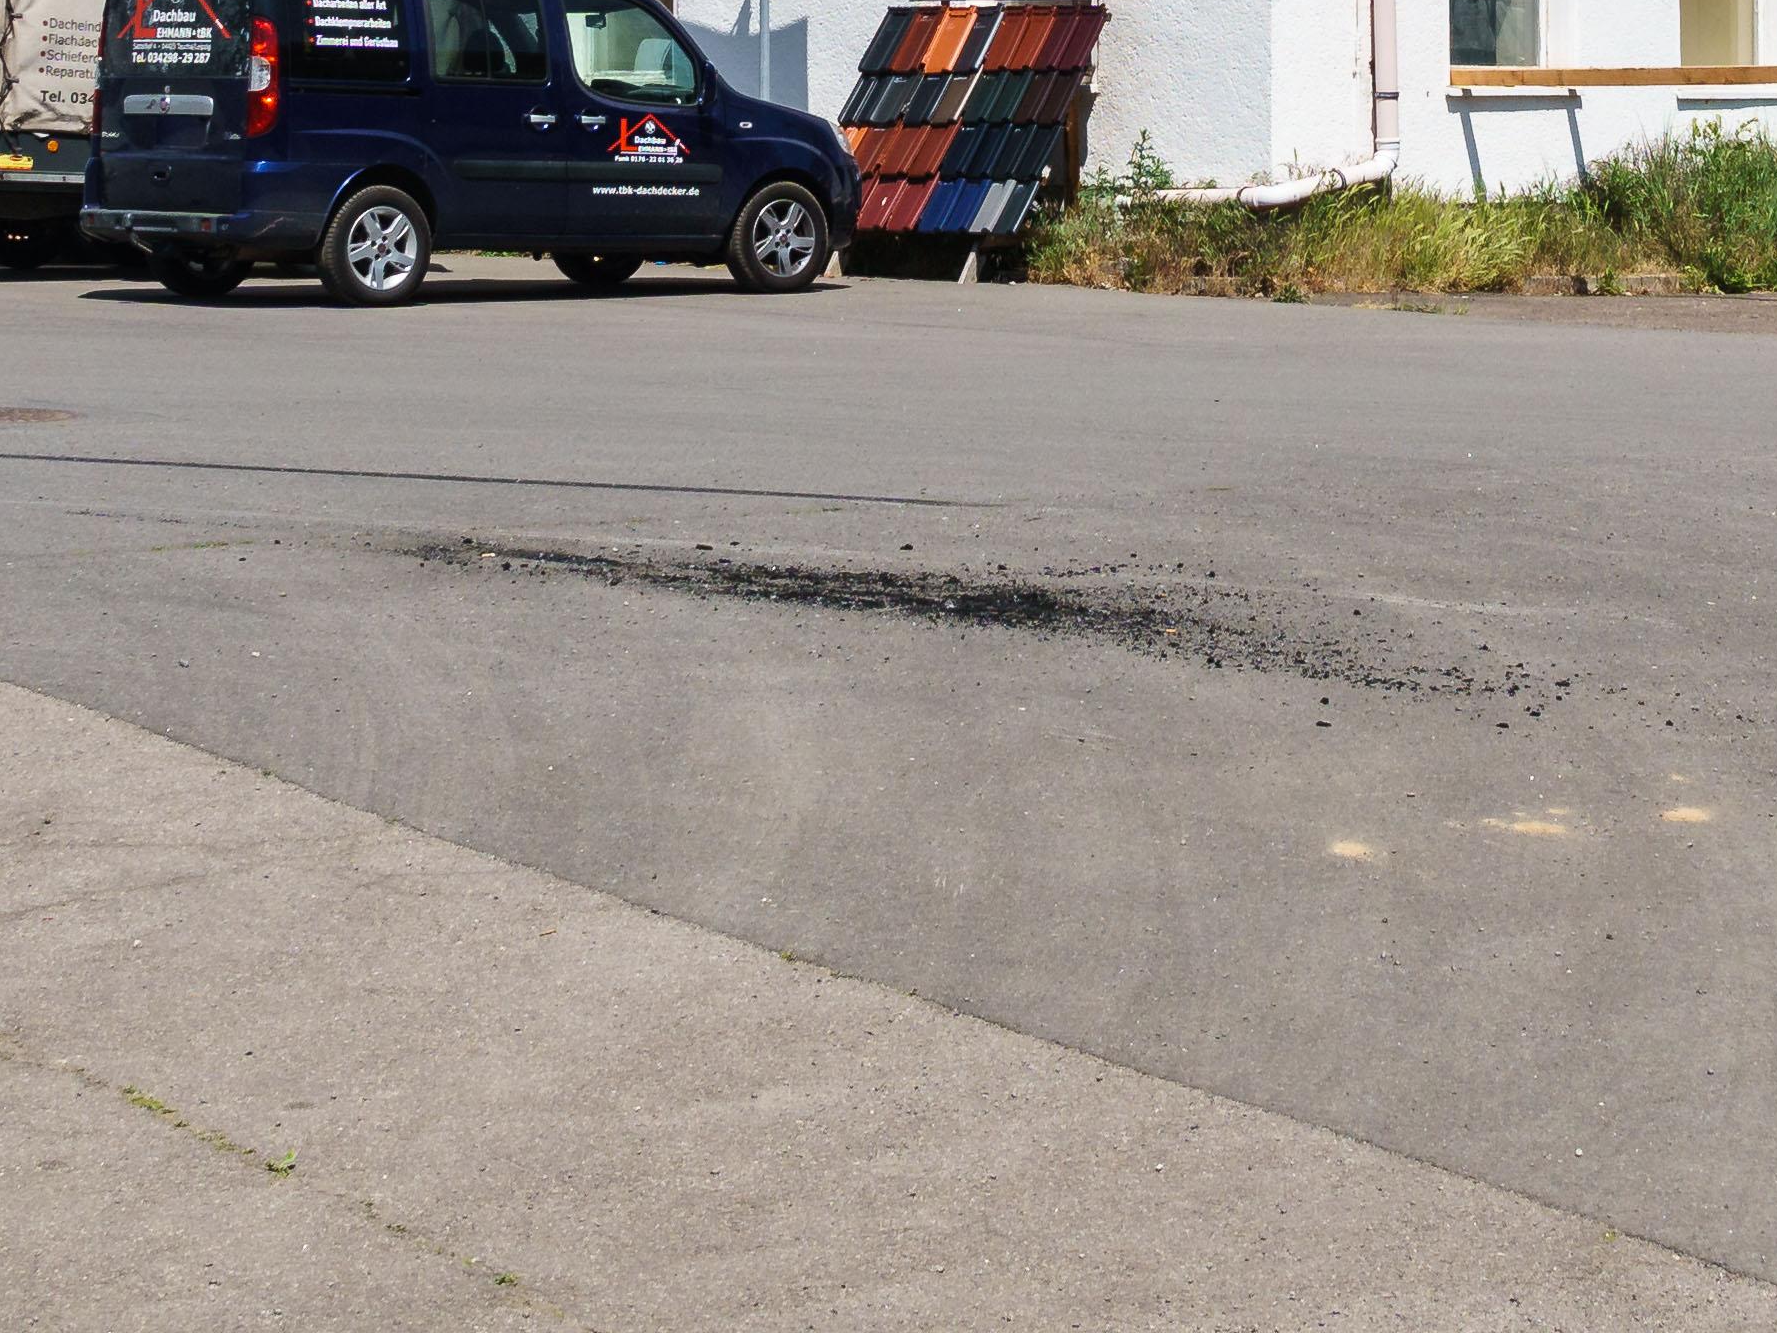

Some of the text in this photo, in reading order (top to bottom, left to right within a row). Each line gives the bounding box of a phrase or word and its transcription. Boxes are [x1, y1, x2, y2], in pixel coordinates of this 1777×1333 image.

[152, 8, 197, 23] Dachbau
[40, 90, 66, 103] Tel.
[592, 185, 700, 197] www.tbk-dachdecker.de
